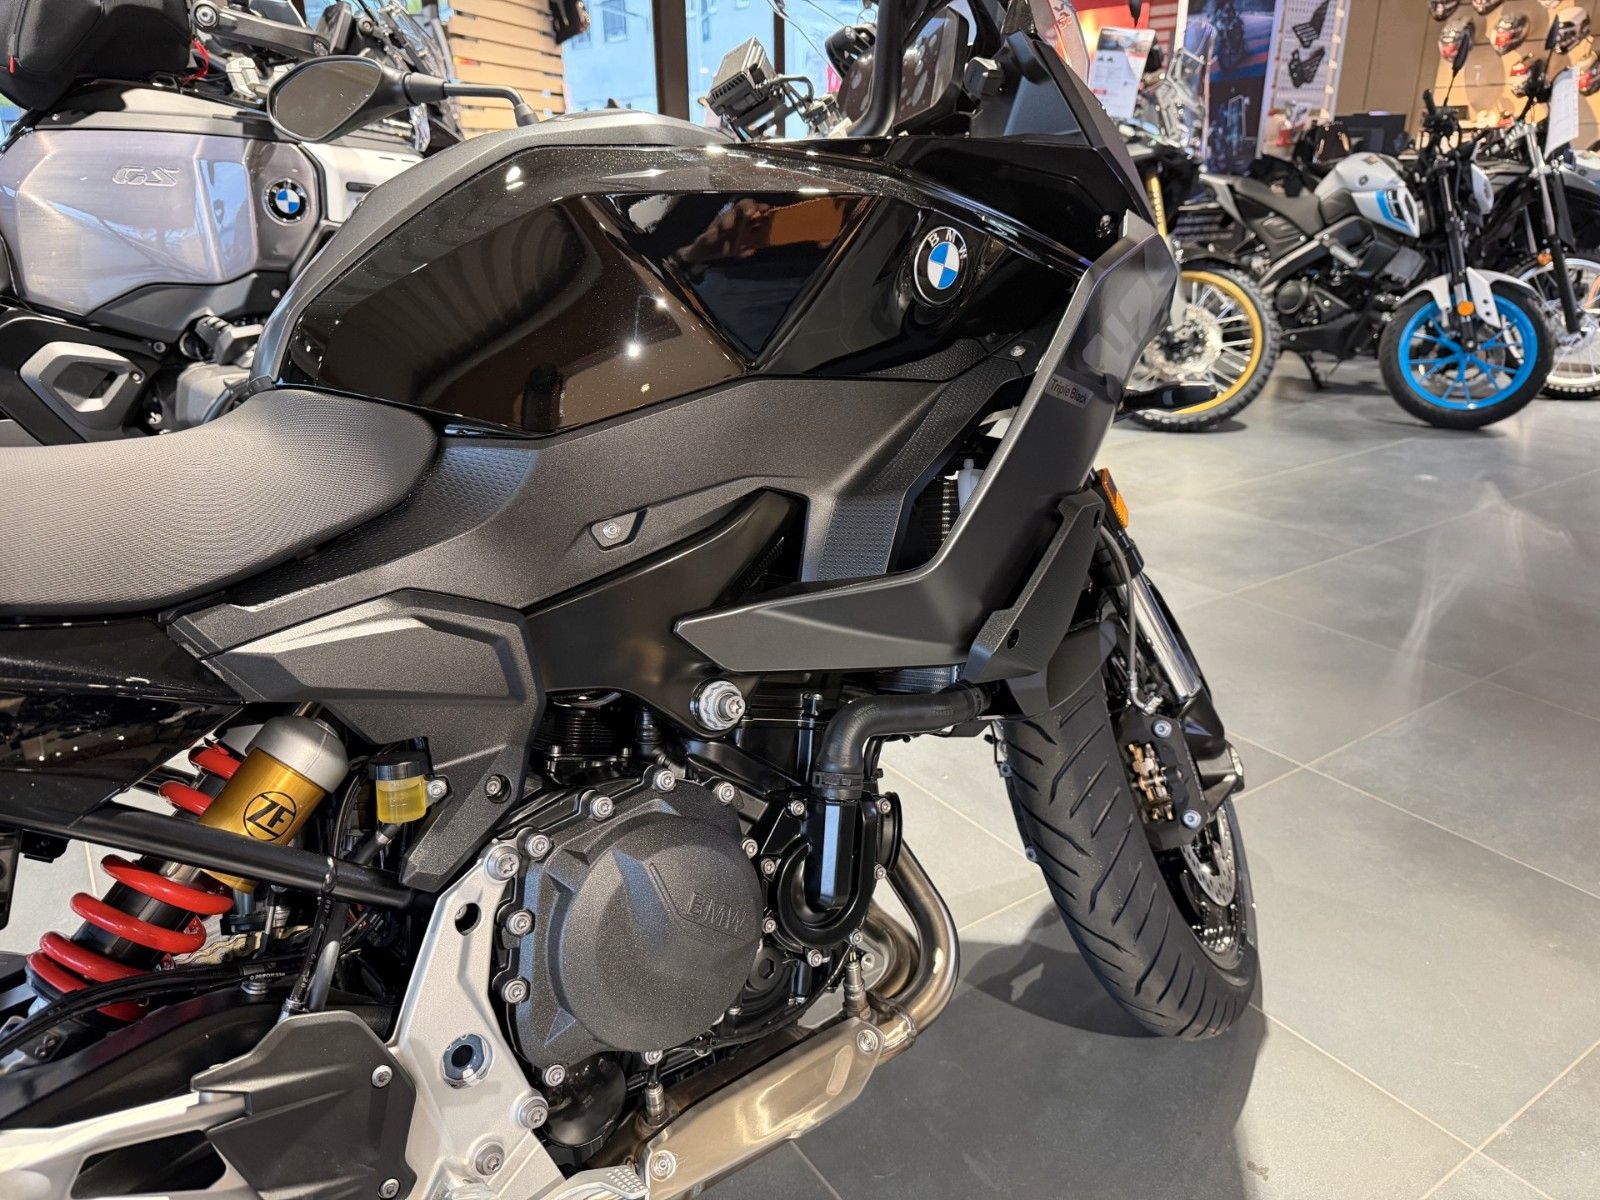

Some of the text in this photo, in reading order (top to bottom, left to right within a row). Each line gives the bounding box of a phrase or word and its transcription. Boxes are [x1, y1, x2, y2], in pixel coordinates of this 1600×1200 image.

[112, 164, 181, 188] GS
[927, 229, 967, 260] BMW
[1050, 379, 1088, 404] Triple Black
[245, 793, 297, 838] ZF
[686, 891, 748, 932] BMW
